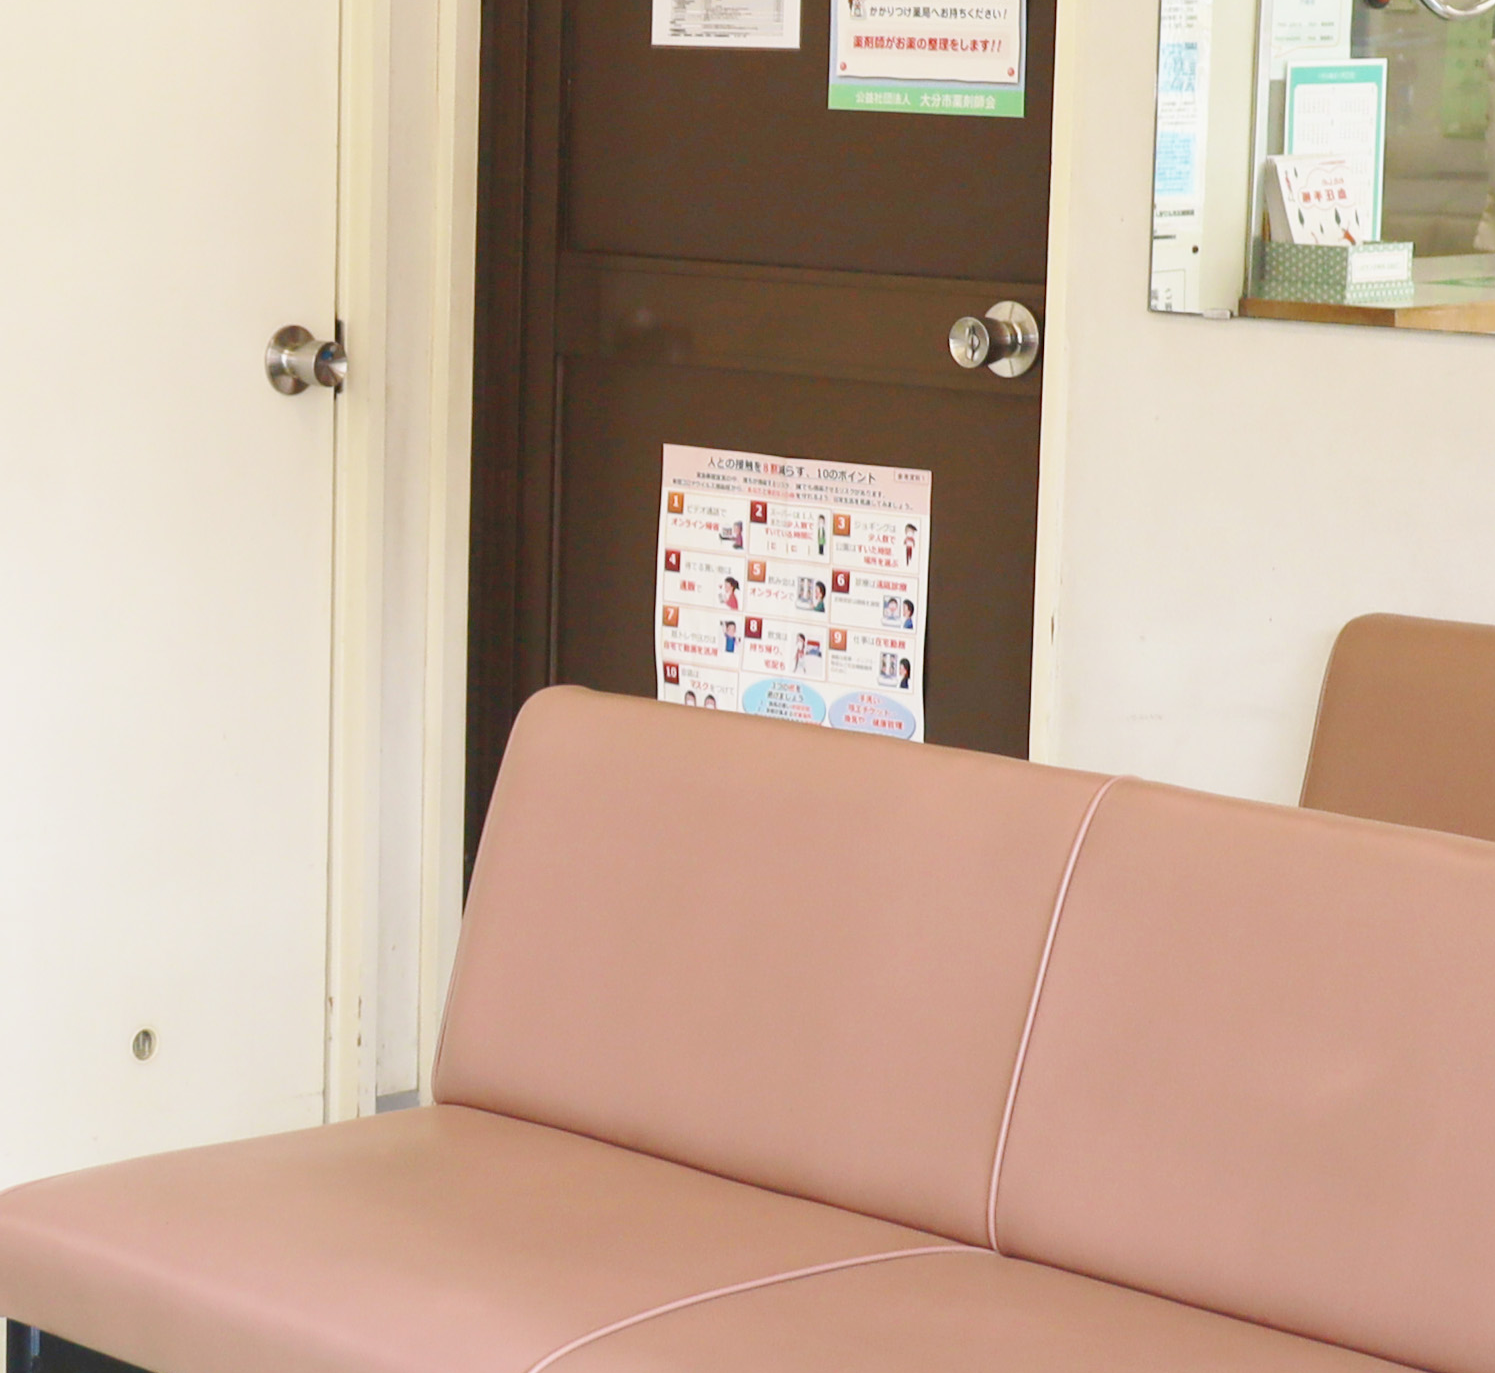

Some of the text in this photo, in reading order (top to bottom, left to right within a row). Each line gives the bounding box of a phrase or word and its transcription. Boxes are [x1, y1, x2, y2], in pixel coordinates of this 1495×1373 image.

[919, 93, 996, 111] 大分市薬剤師会
[672, 495, 679, 508] 1
[755, 504, 763, 518] 2
[838, 517, 846, 530] 3
[669, 553, 677, 566] 4
[752, 563, 761, 576] 5
[837, 573, 845, 587] 6
[667, 608, 675, 621] 7
[749, 619, 758, 633] 8
[833, 630, 842, 644] 9
[665, 665, 677, 679] 10
